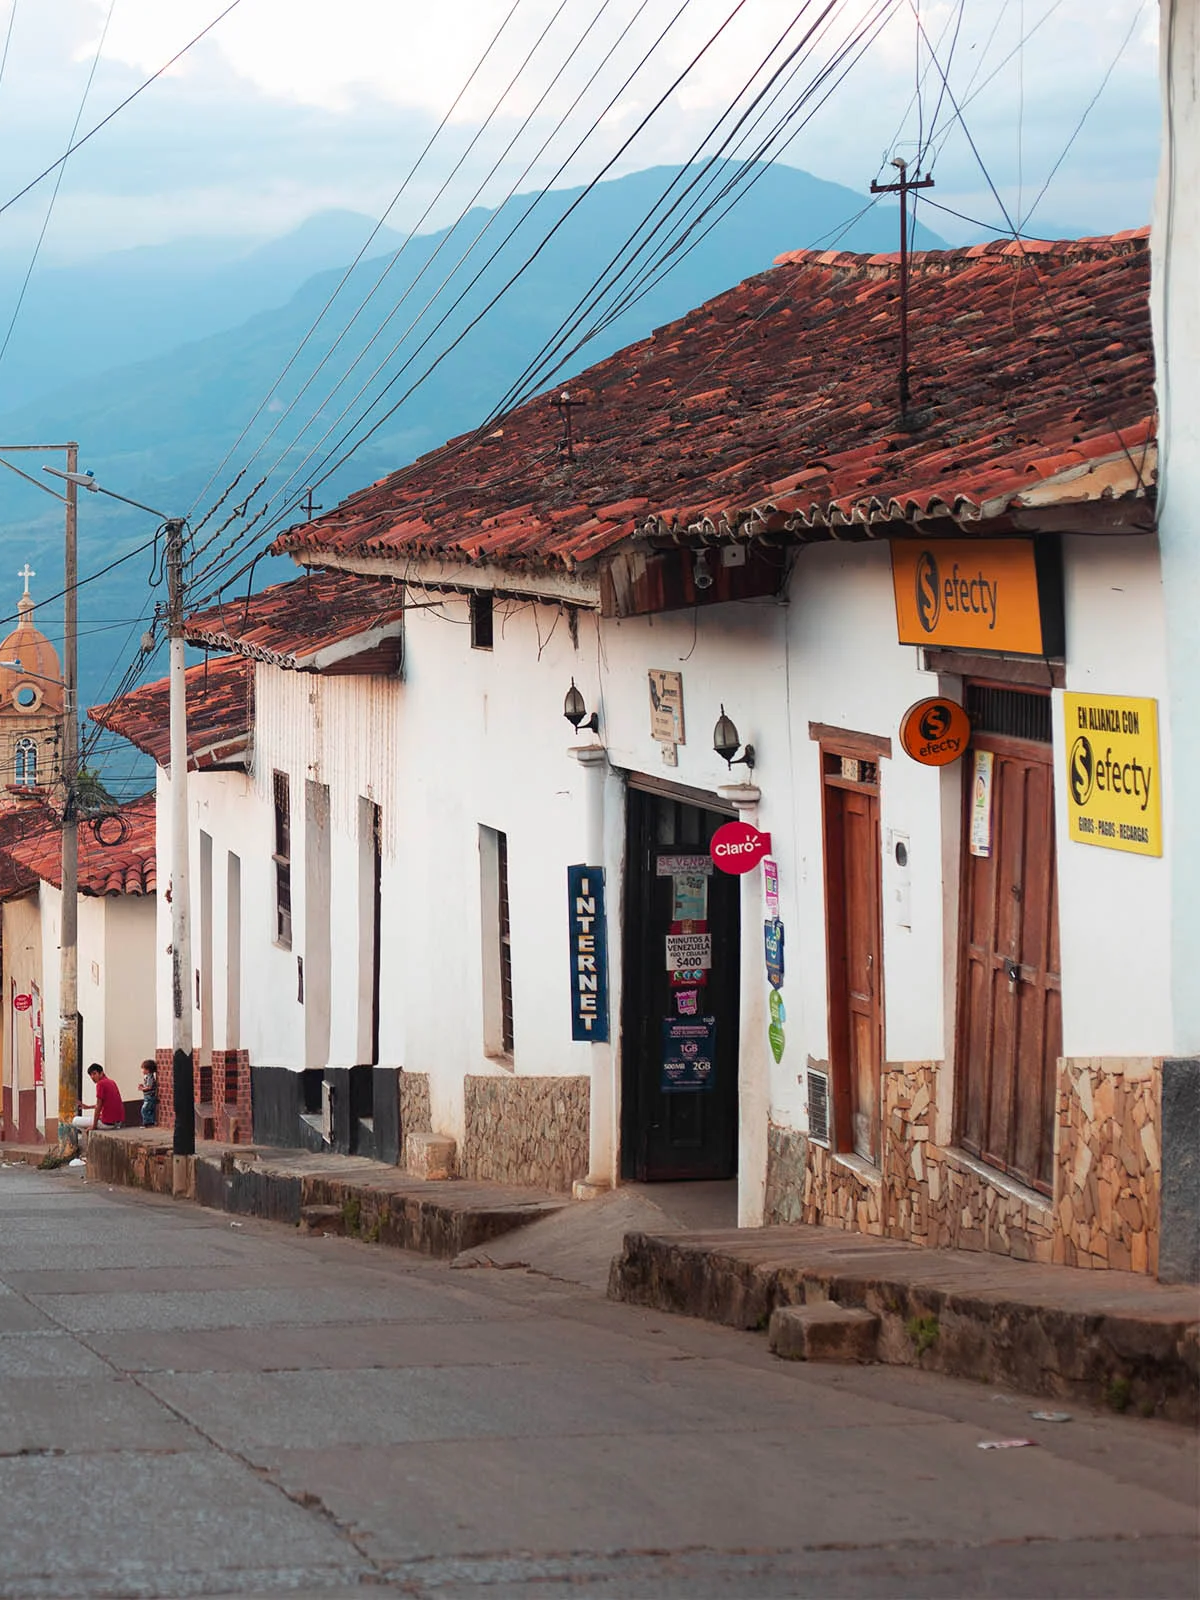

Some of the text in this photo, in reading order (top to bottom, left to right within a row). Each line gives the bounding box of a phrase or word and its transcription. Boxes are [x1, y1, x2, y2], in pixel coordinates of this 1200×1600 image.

[944, 563, 998, 630] efecty
[1077, 706, 1140, 735] EN ALIANZA CON
[920, 737, 961, 757] efecty
[1095, 747, 1152, 811] efecty
[1078, 816, 1149, 843] GIROS PAGOS RECARGAS
[715, 841, 755, 856] Claro
[658, 856, 673, 866] SE
[667, 935, 710, 945] MINUTOS A
[667, 943, 710, 952] VENEZUELA
[576, 878, 598, 1031] INTERNET
[676, 957, 702, 968] $400
[680, 1043, 698, 1053] 1GB
[692, 1061, 712, 1071] 2GB
